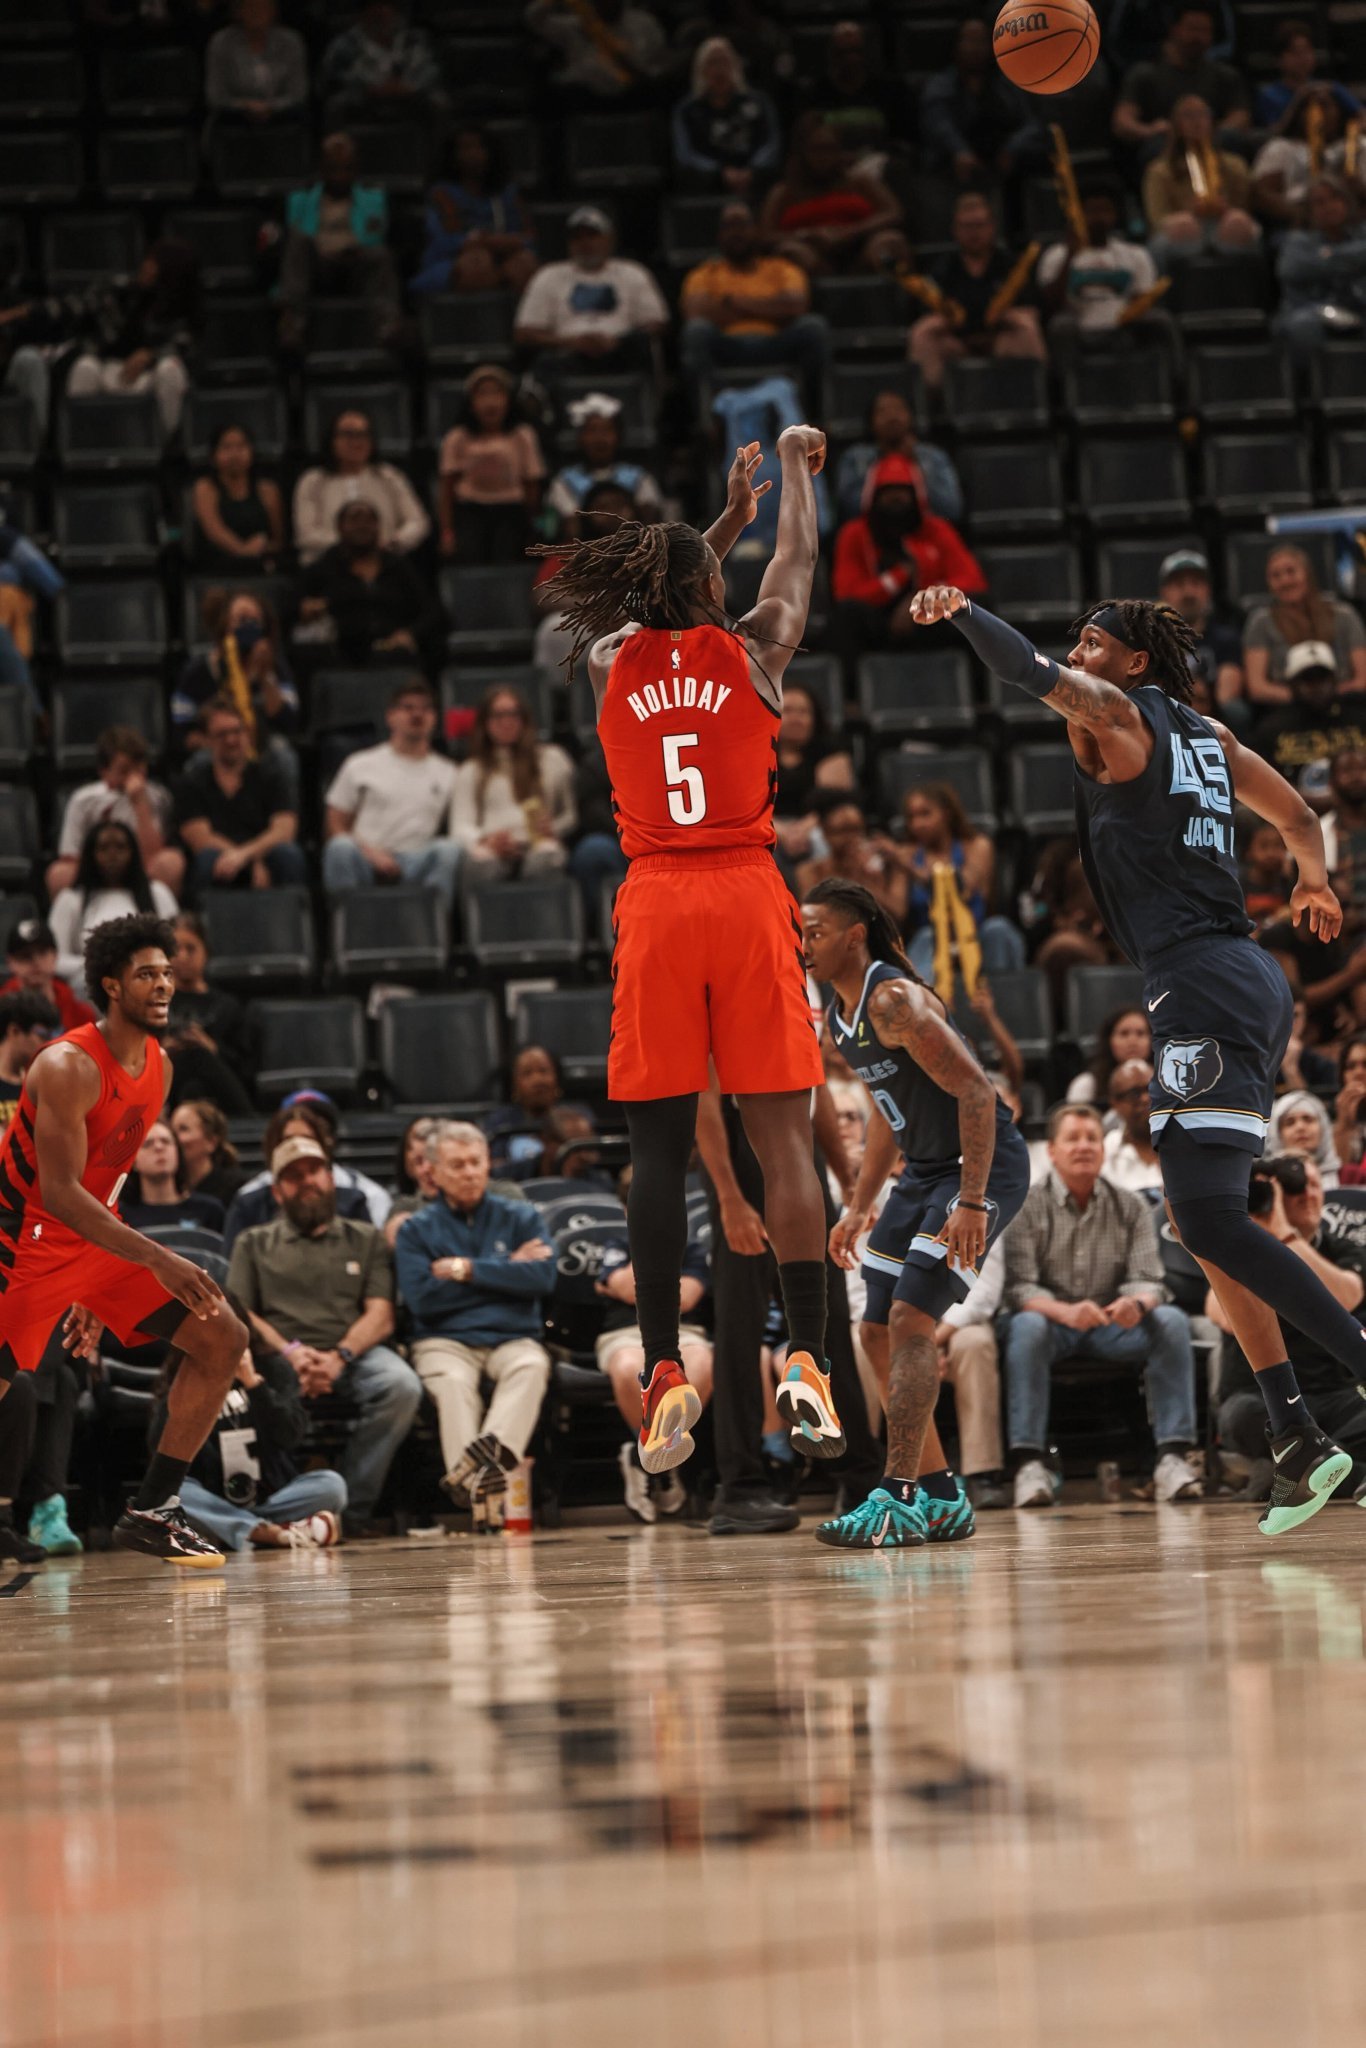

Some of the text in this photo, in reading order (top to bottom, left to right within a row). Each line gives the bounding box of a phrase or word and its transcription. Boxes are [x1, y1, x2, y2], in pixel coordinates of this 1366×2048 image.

[627, 677, 732, 722] HOLIDAY
[662, 733, 707, 826] 5
[1169, 732, 1232, 815] 45
